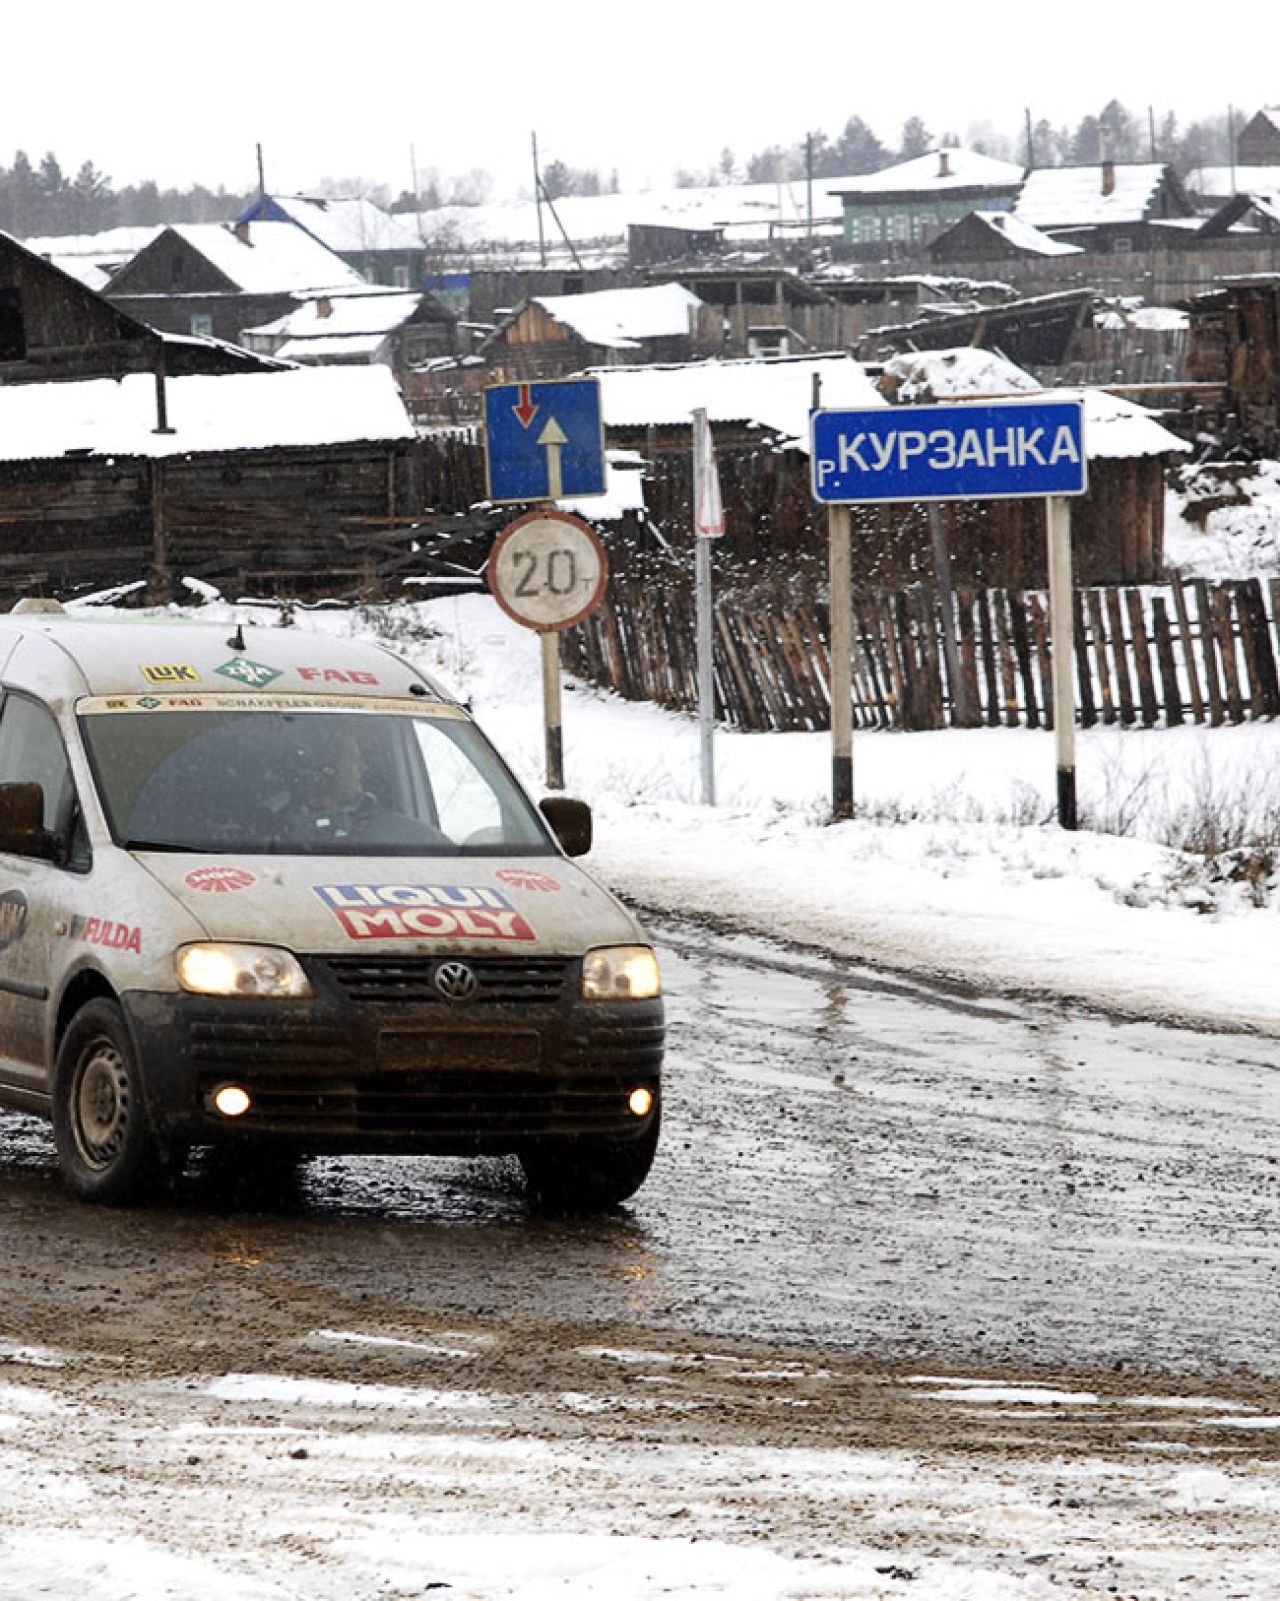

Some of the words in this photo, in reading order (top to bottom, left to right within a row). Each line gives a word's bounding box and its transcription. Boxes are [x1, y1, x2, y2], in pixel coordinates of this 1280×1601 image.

[838, 425, 1080, 473] КУРЗАНКА
[513, 549, 575, 597] 20
[296, 667, 380, 686] FAG
[325, 886, 505, 907] LIQUI
[81, 917, 142, 953] FULDA
[344, 909, 519, 936] MOLY
